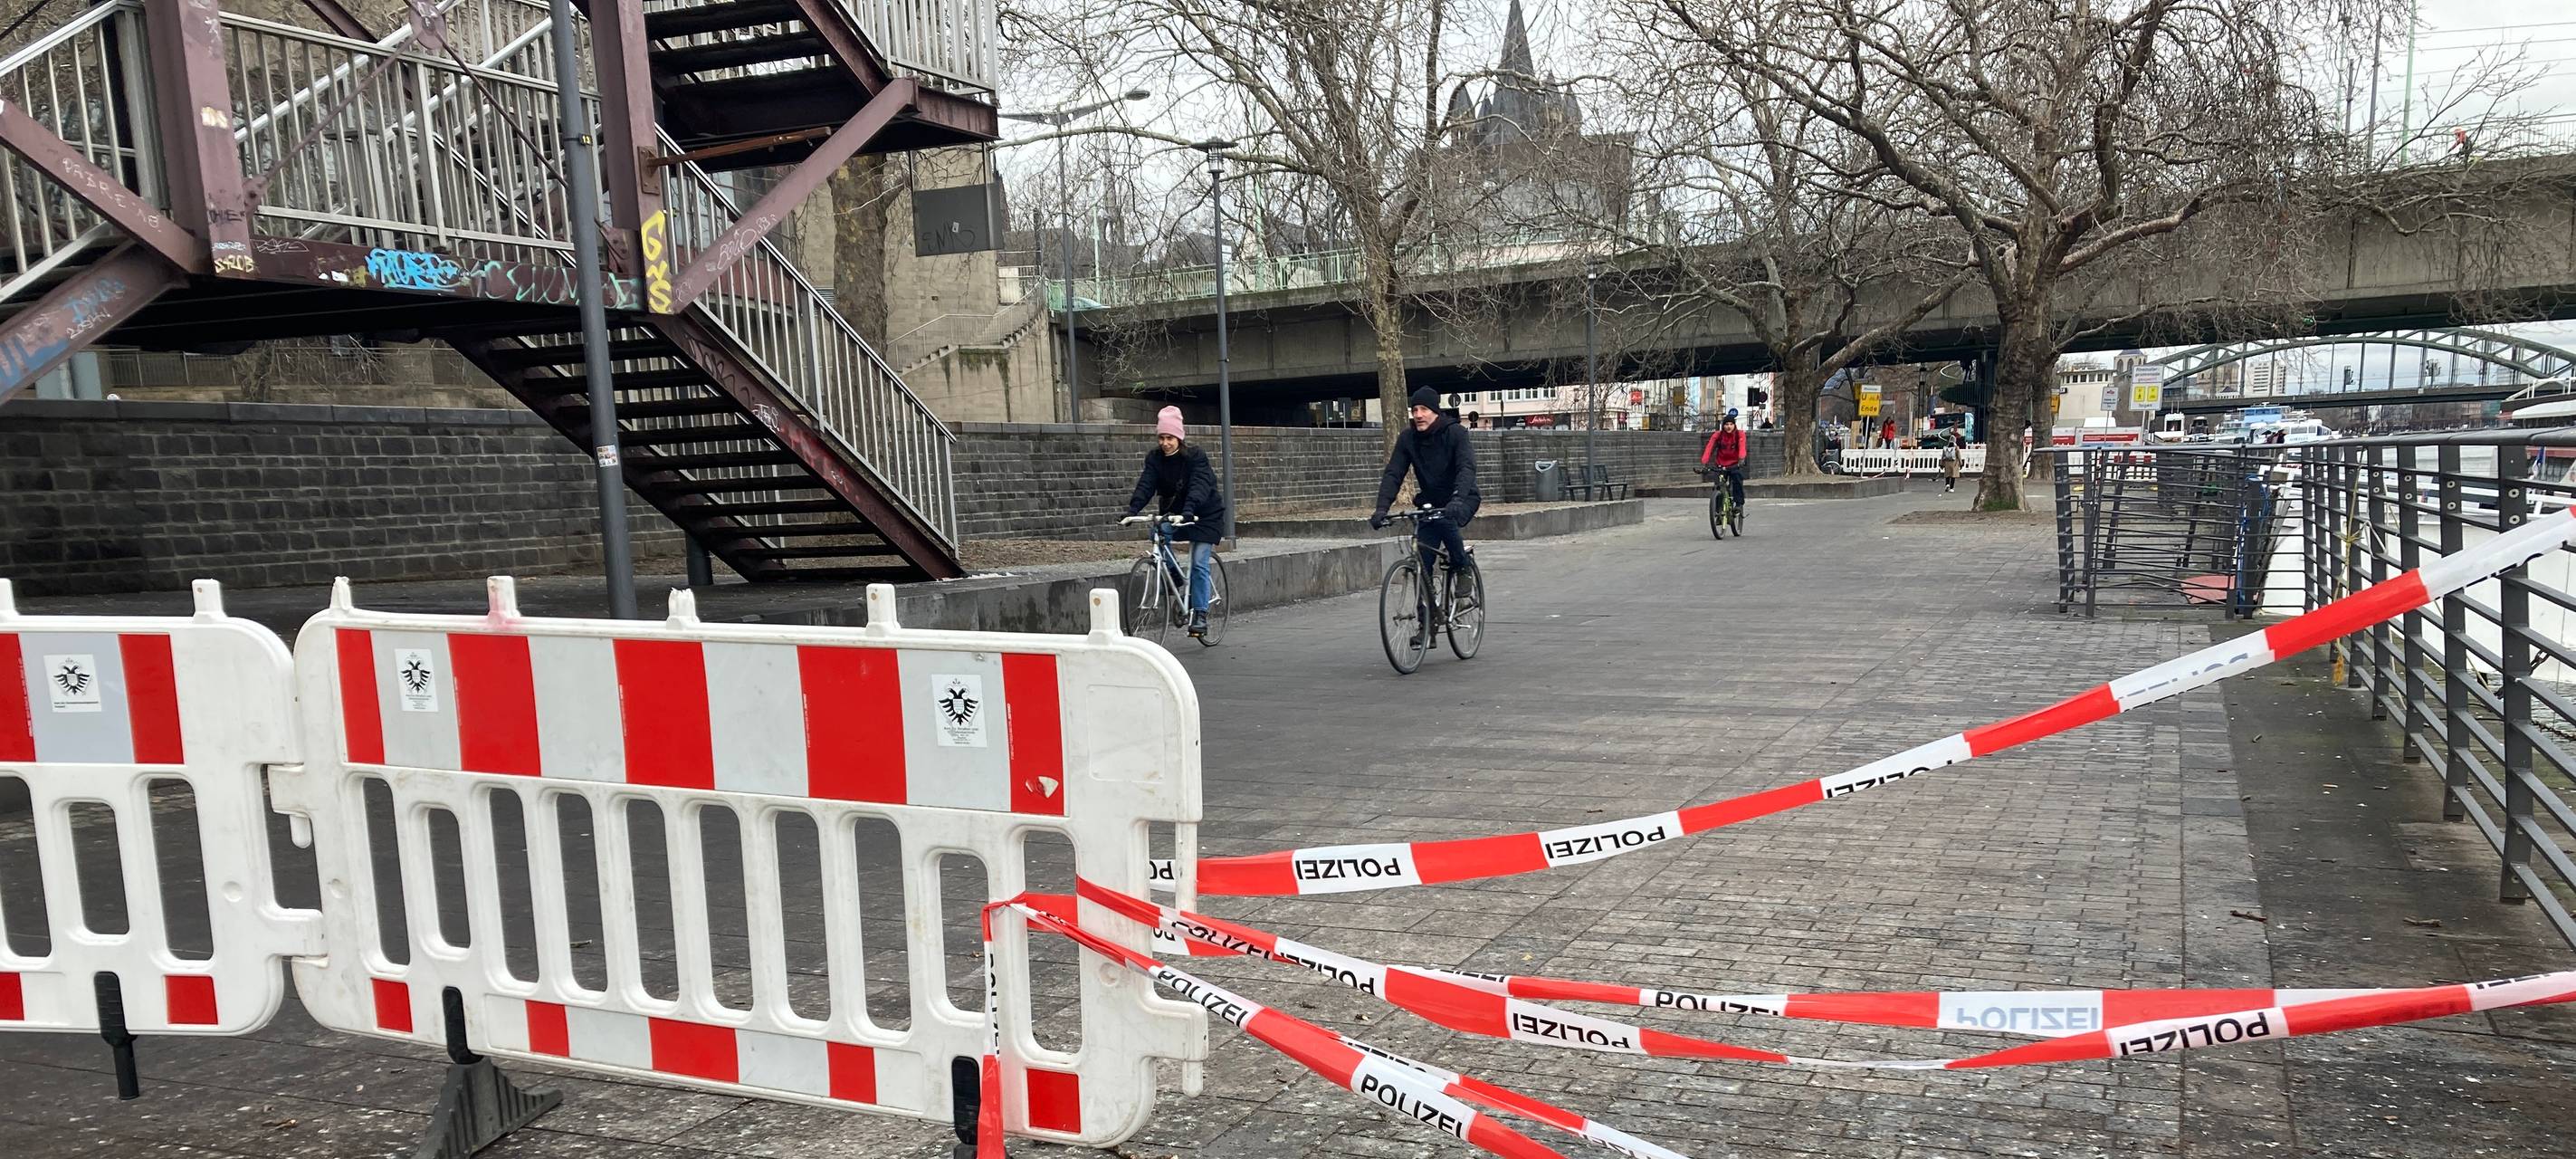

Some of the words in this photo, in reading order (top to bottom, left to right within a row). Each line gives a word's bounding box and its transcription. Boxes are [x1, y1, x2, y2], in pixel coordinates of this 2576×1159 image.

[1545, 826, 1666, 859] POLIZEI
[1295, 857, 1401, 880] POLIZEI
[1158, 970, 1249, 1028] POLIZEI
[1513, 1012, 1630, 1049] POLIZEI
[1360, 1073, 1463, 1139] POLIZEI
